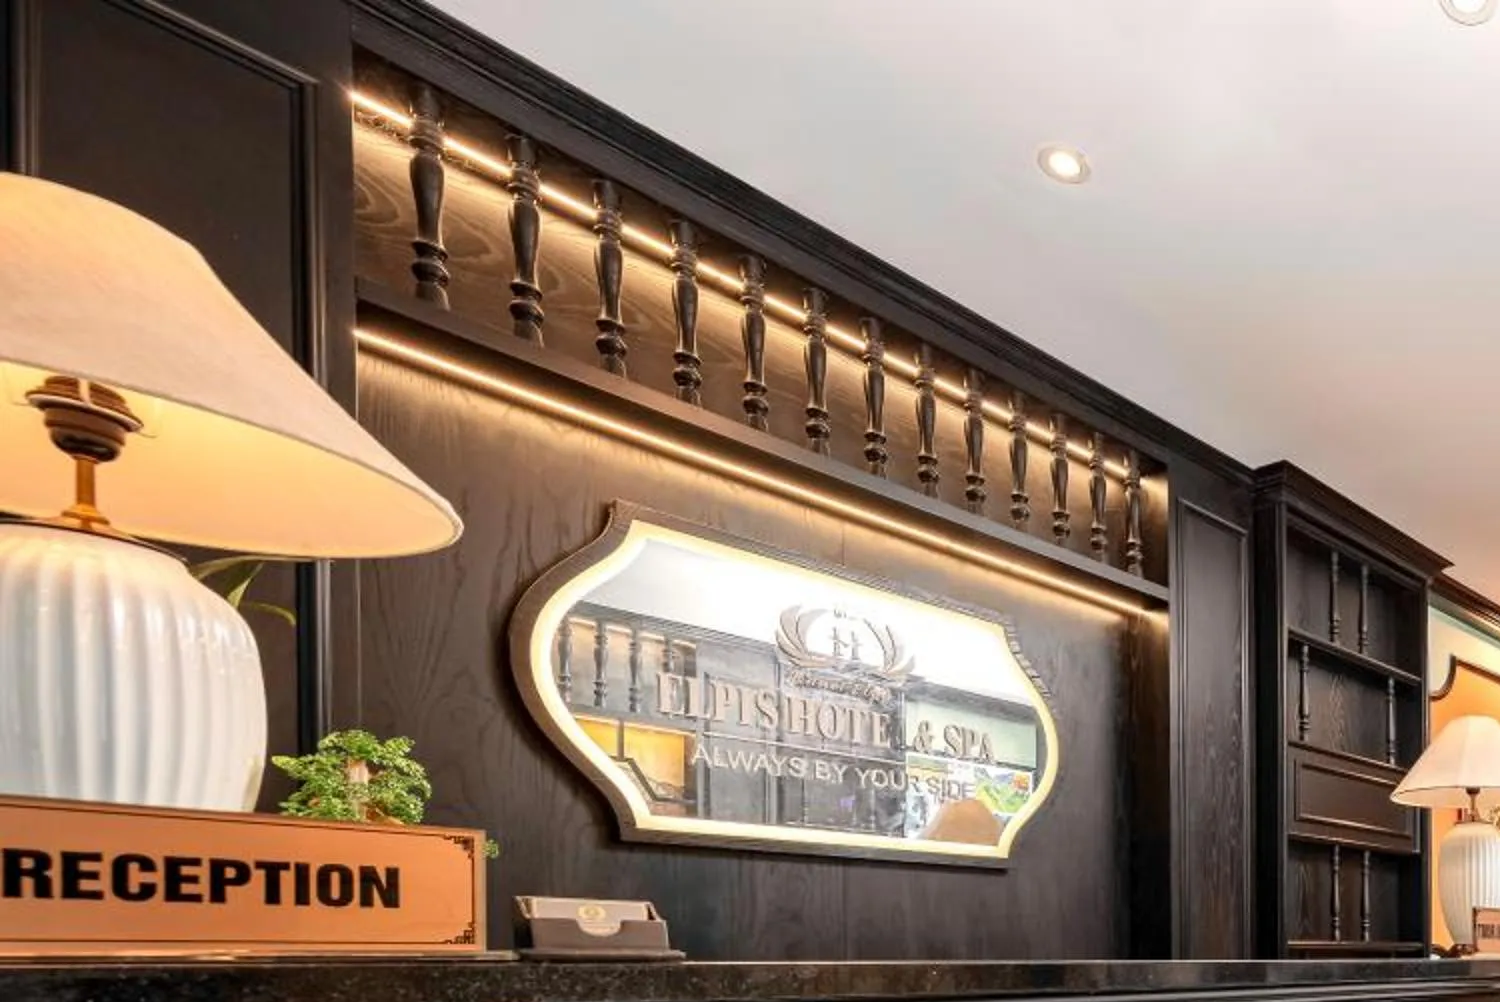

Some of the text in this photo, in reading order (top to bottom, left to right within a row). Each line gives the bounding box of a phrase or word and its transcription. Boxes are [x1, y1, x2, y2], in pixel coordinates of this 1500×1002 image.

[656, 671, 779, 730] ELPIS
[785, 695, 904, 752] HOTE
[914, 720, 935, 752] &
[943, 724, 996, 764] SPA
[691, 743, 976, 801] ALWAYS BY YOUR SIDE
[1, 847, 401, 909] RECEPTION
